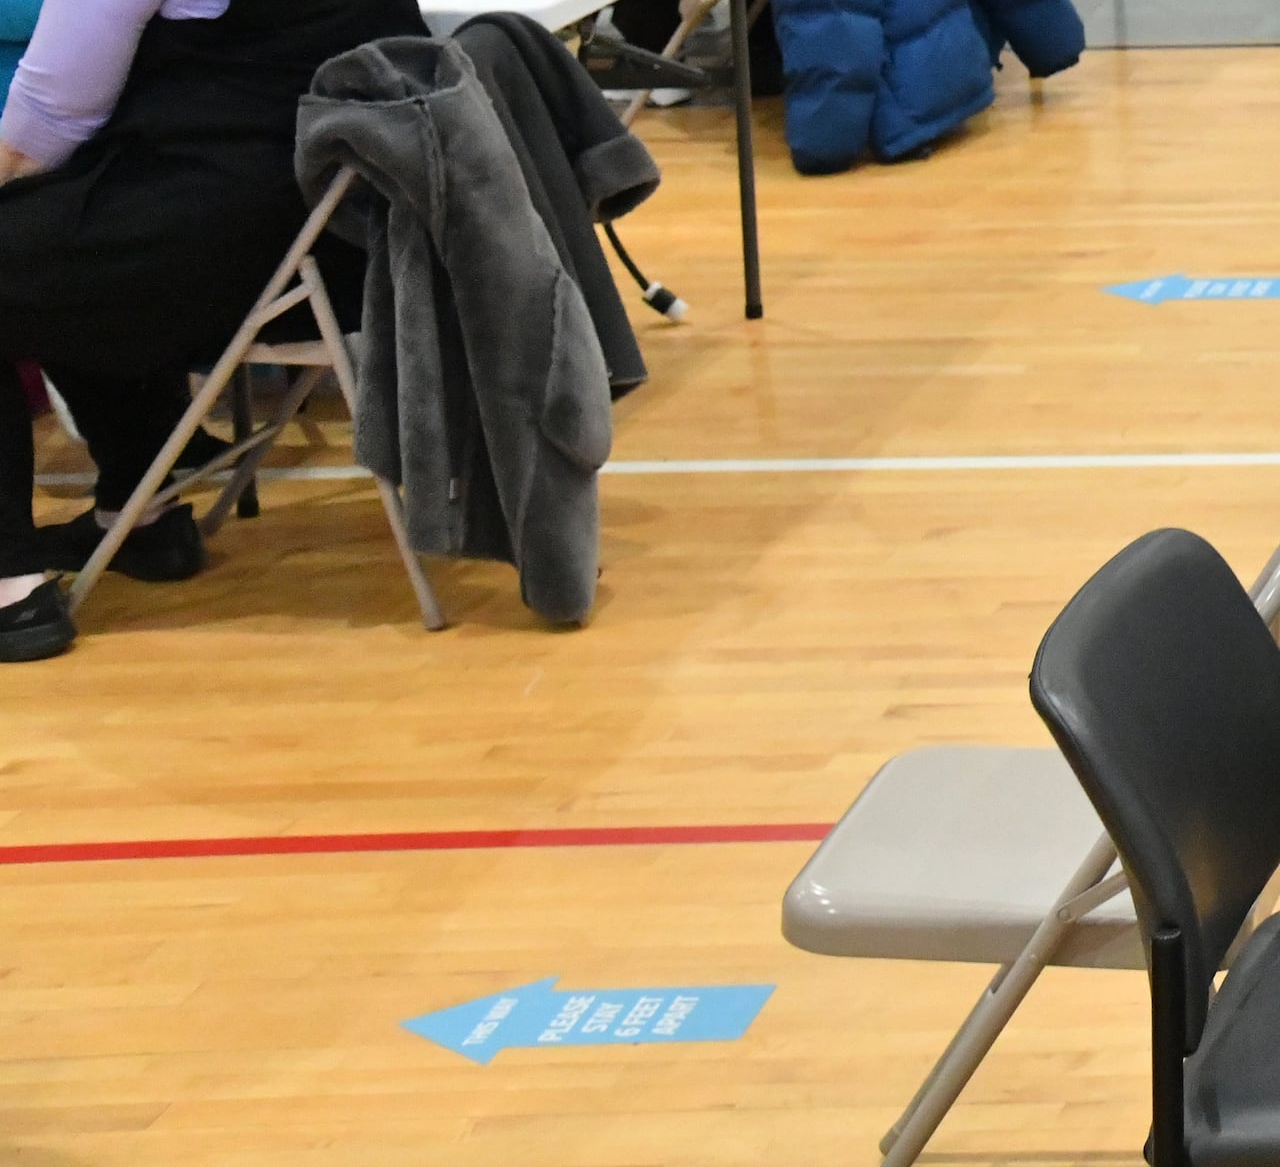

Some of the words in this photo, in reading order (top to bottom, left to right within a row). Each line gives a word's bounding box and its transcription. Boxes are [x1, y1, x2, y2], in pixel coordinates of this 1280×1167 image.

[537, 995, 596, 1043] PLEASE
[581, 1002, 625, 1034] STAY
[622, 996, 665, 1026] FEET
[651, 995, 700, 1036] APART
[613, 1026, 641, 1038] 6
